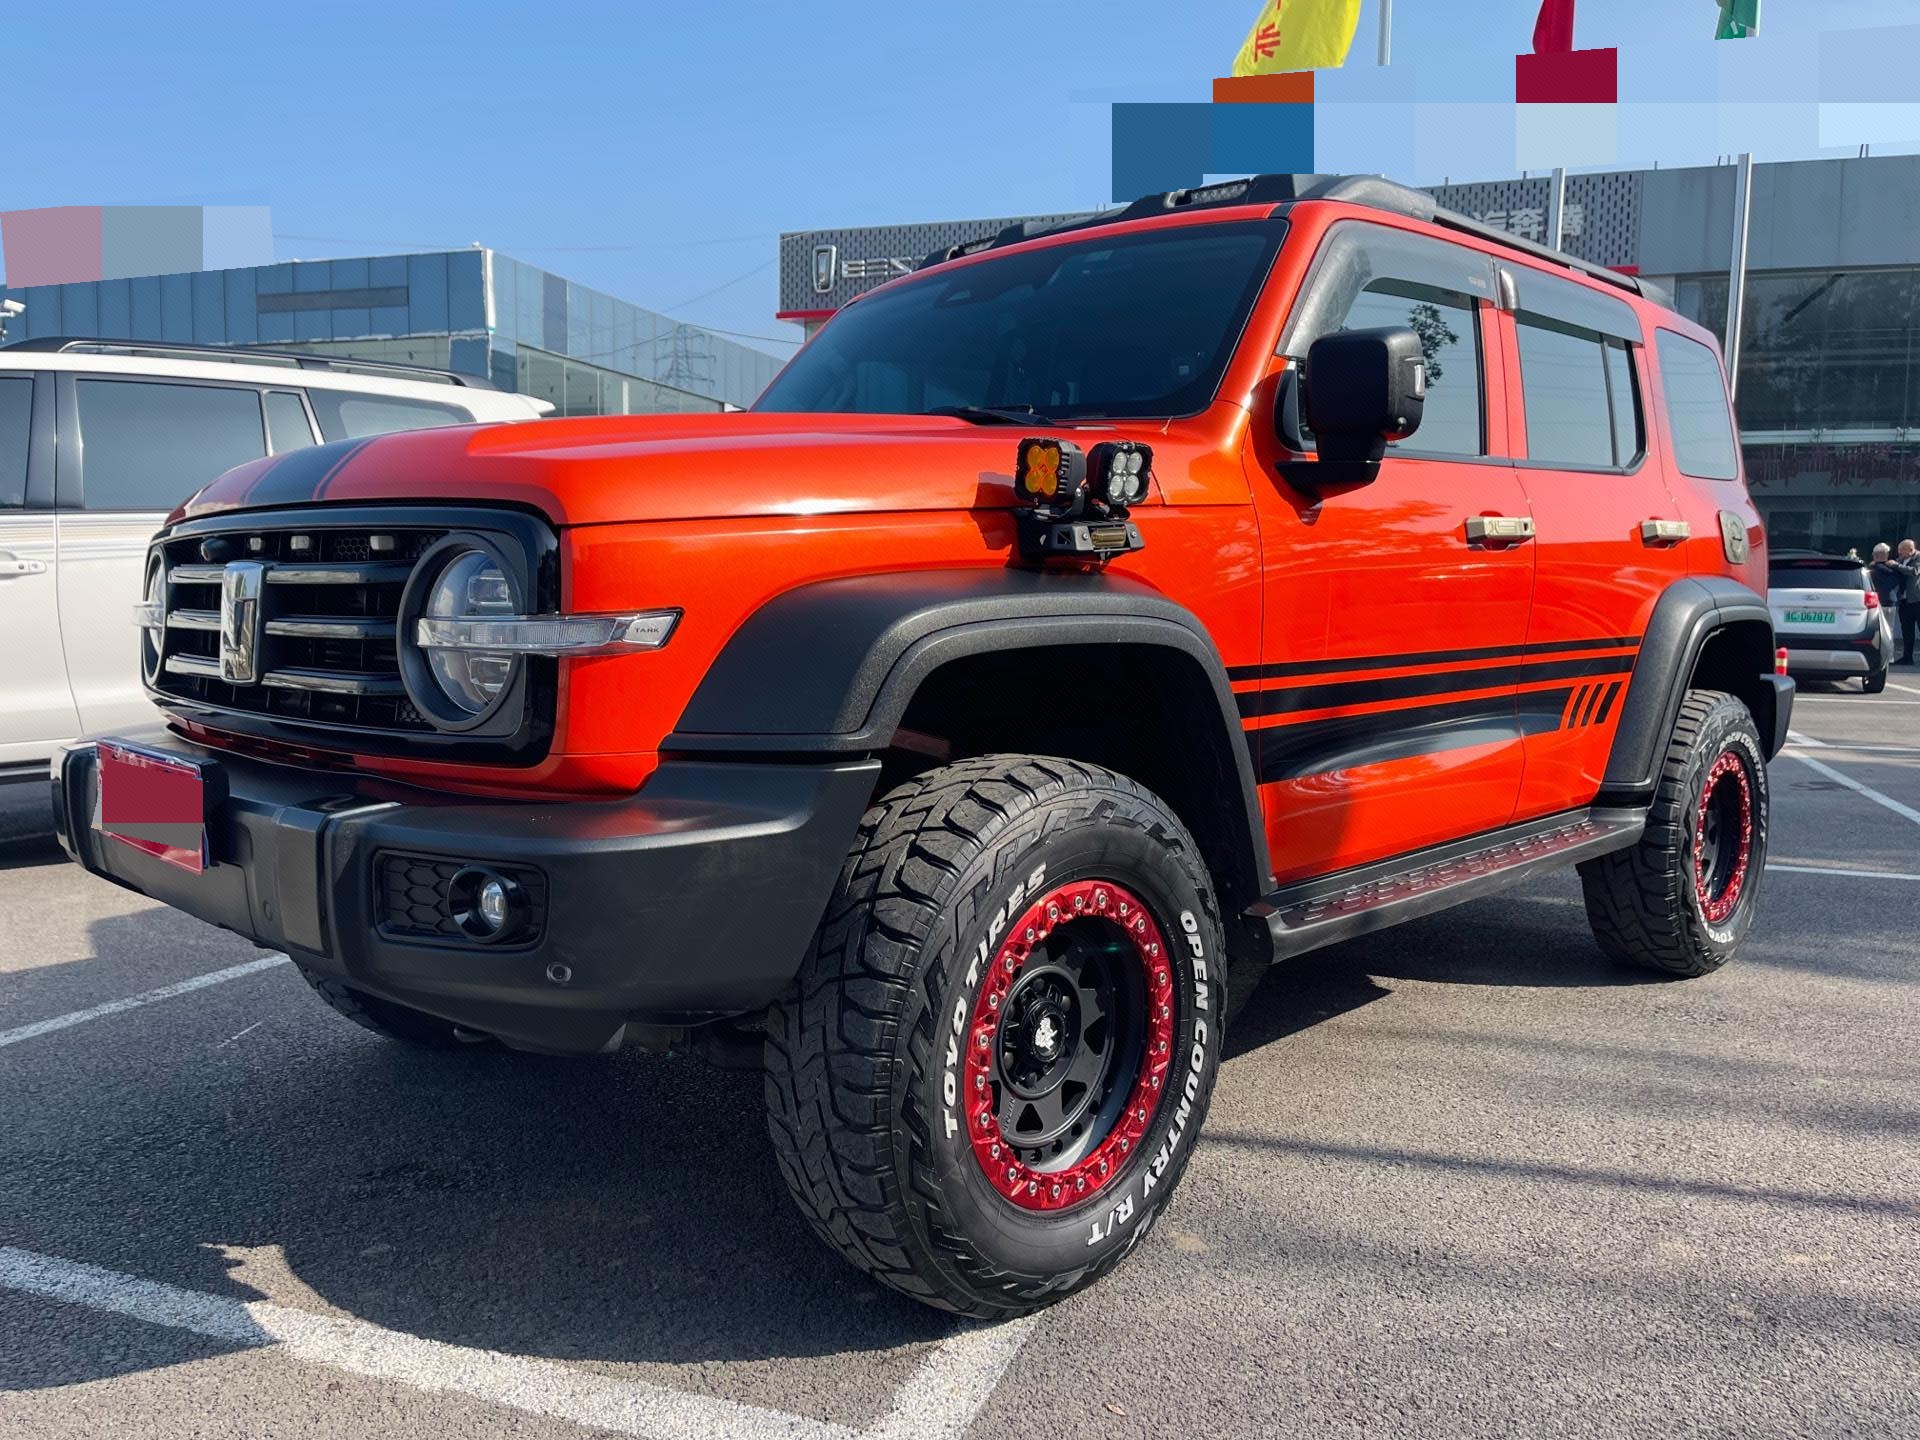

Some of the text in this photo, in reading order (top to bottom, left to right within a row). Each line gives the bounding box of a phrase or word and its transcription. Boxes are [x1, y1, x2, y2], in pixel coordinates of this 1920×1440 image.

[942, 862, 1047, 1139] TOYO TIRES
[1179, 910, 1210, 1012] OPEN
[1143, 1016, 1208, 1199] COUNTRY
[1087, 1193, 1135, 1247] R/T
